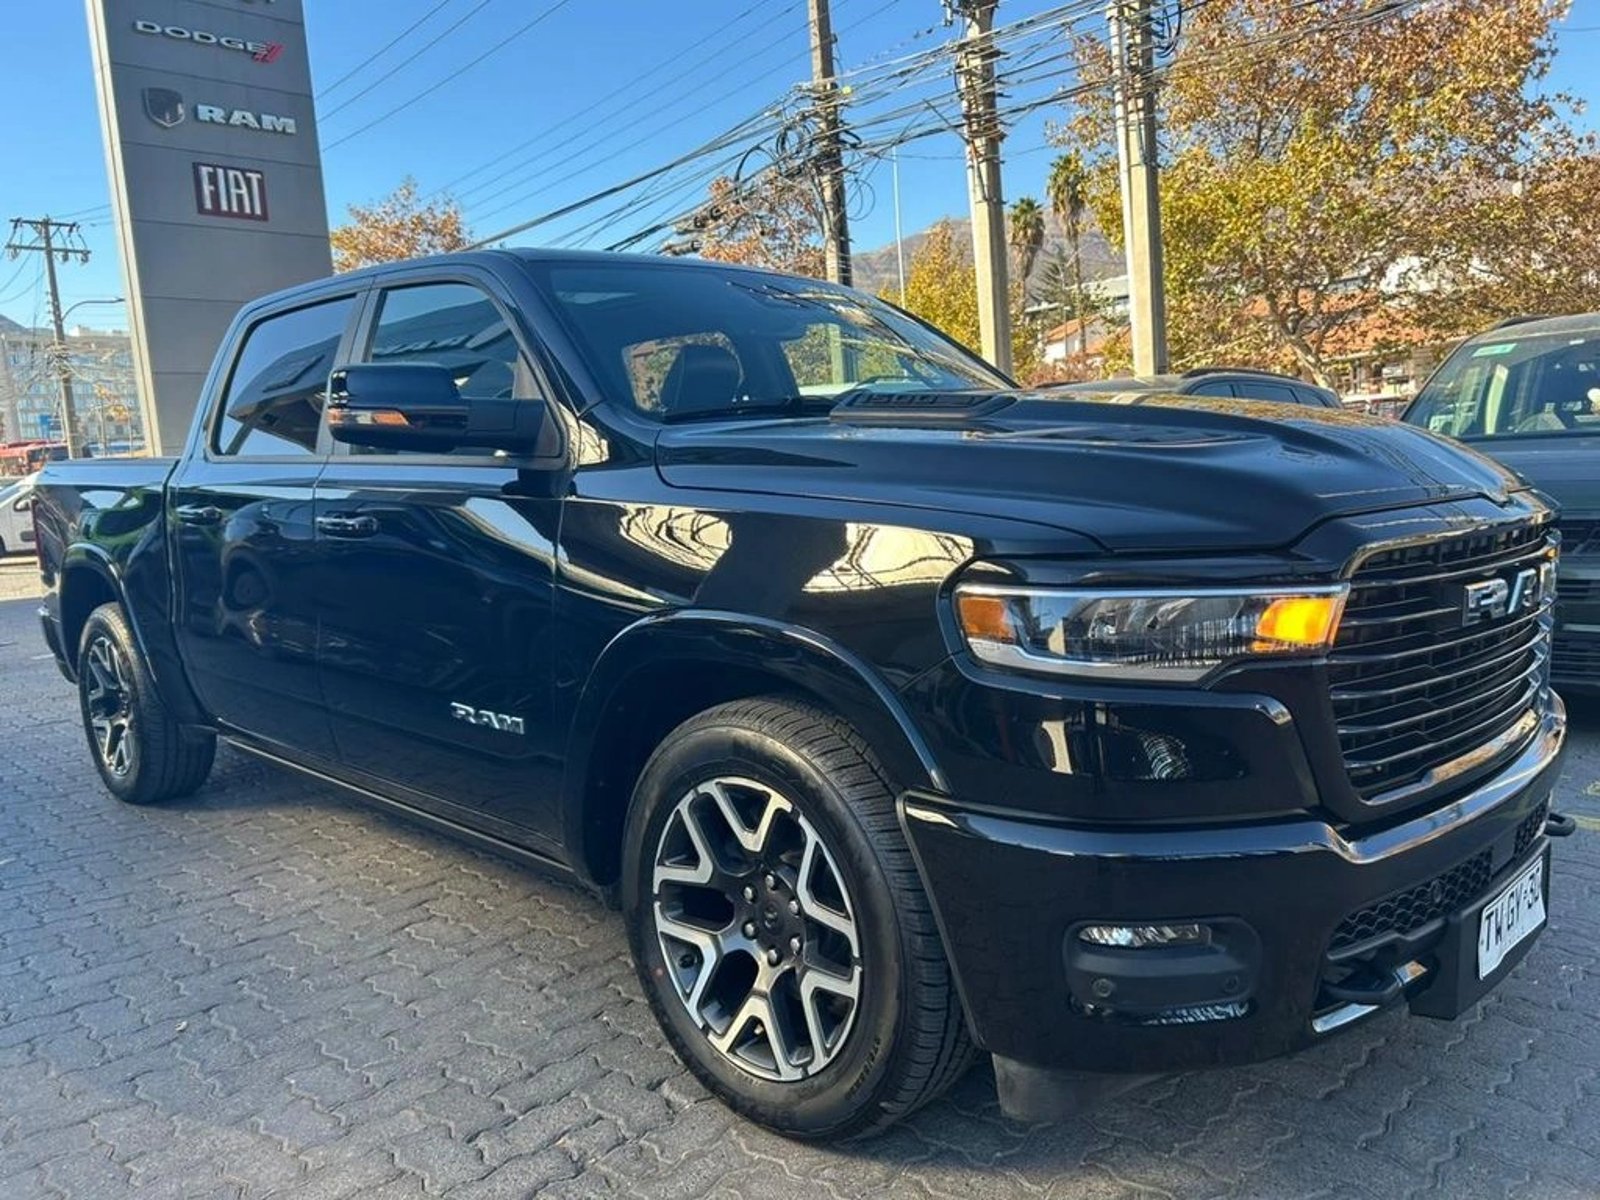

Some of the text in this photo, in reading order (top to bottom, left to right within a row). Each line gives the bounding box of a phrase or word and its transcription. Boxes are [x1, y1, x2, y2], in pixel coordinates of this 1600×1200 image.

[134, 20, 268, 55] DODGE
[196, 104, 297, 135] RAM
[198, 165, 262, 215] FIAT
[450, 701, 525, 735] RAM
